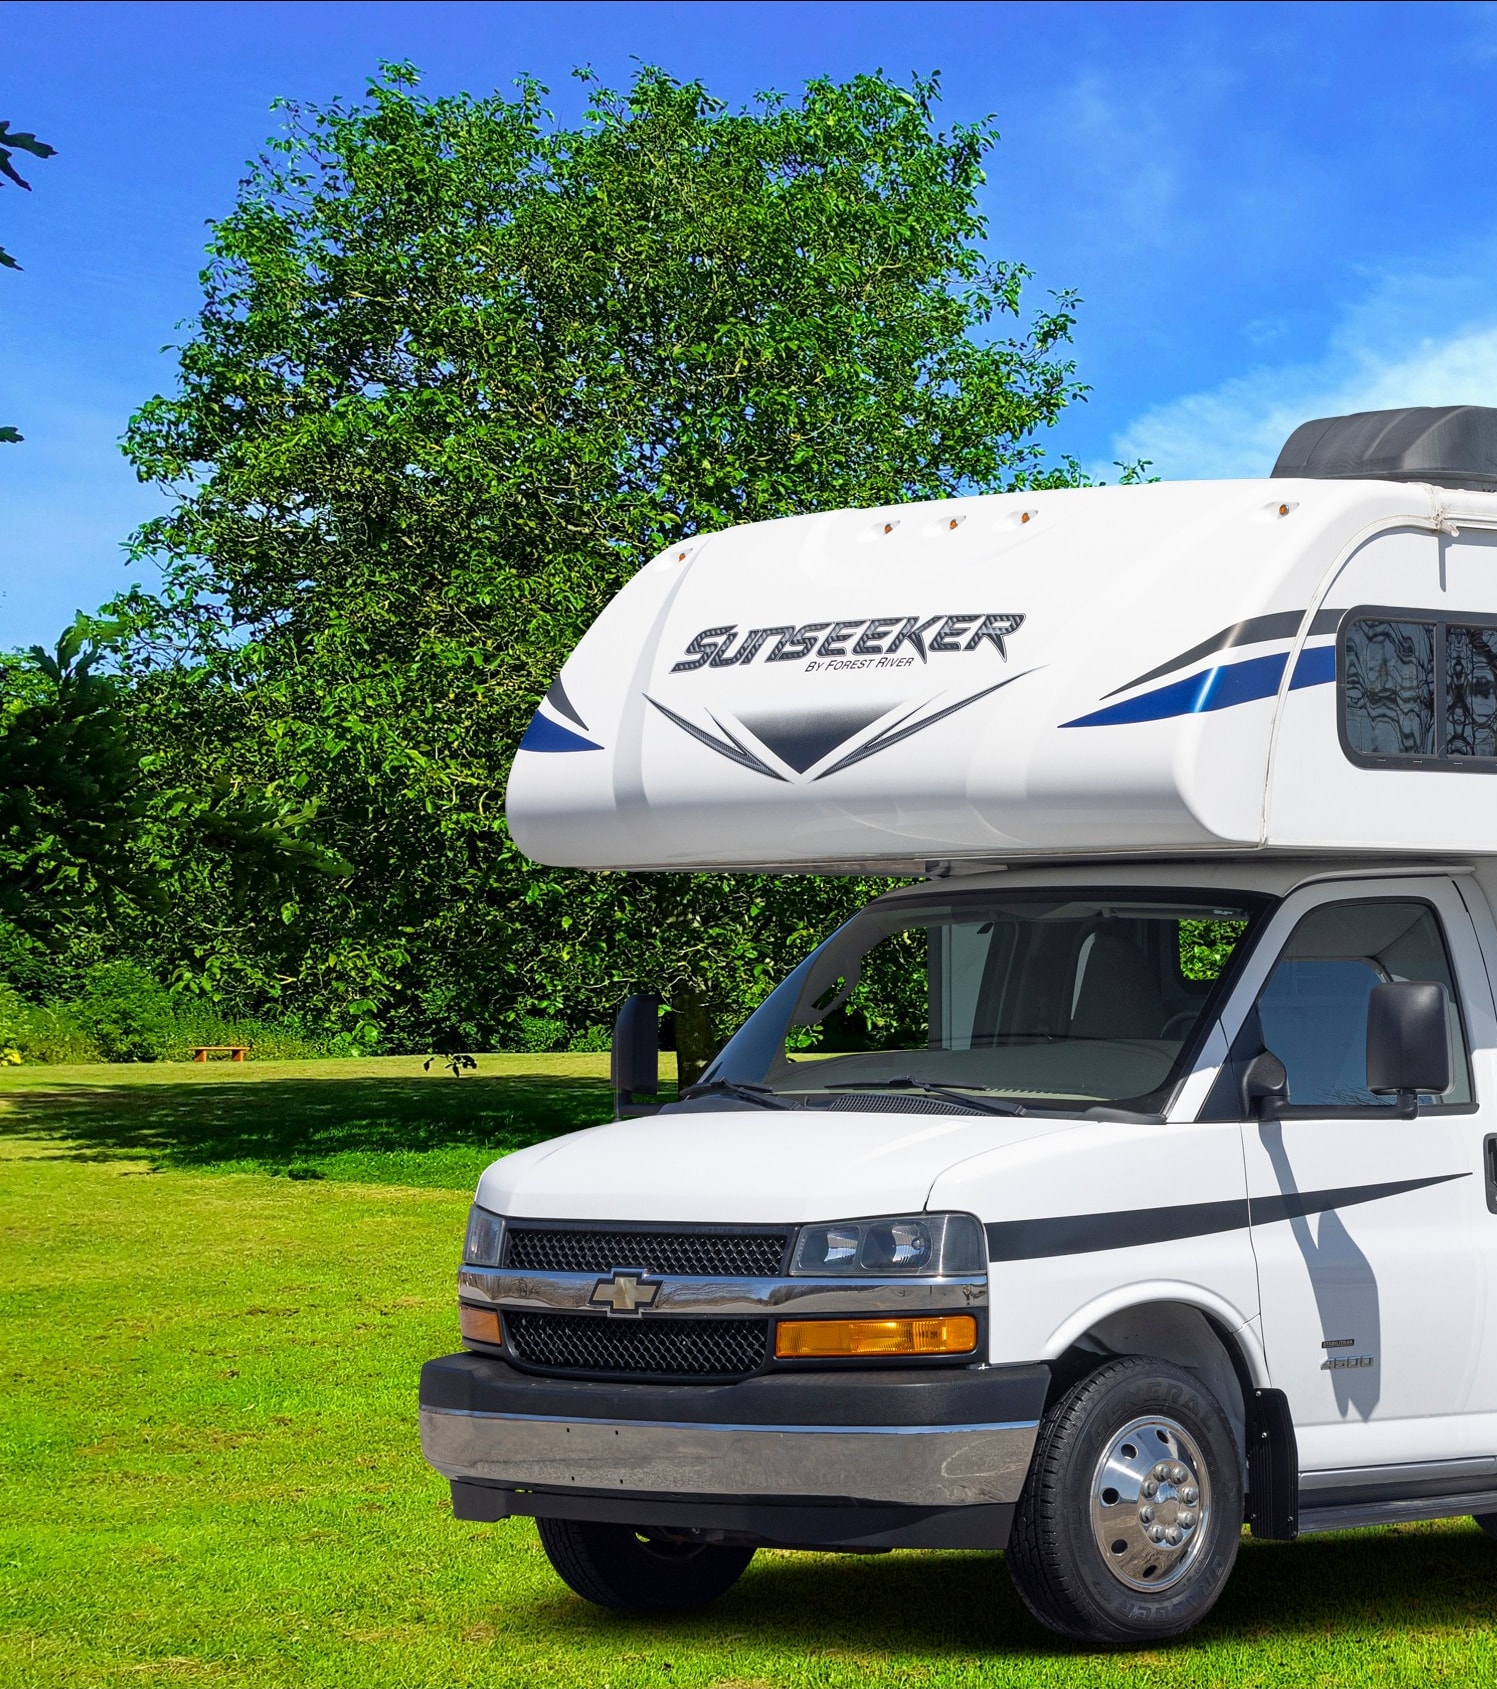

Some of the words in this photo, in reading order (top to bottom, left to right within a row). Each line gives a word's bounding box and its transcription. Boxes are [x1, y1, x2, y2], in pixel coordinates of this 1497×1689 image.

[669, 613, 1026, 674] SUNSEEKER
[805, 661, 825, 672] BY
[825, 659, 875, 671] FOREST
[876, 657, 915, 668] RIVER
[1321, 1355, 1374, 1370] 4500
